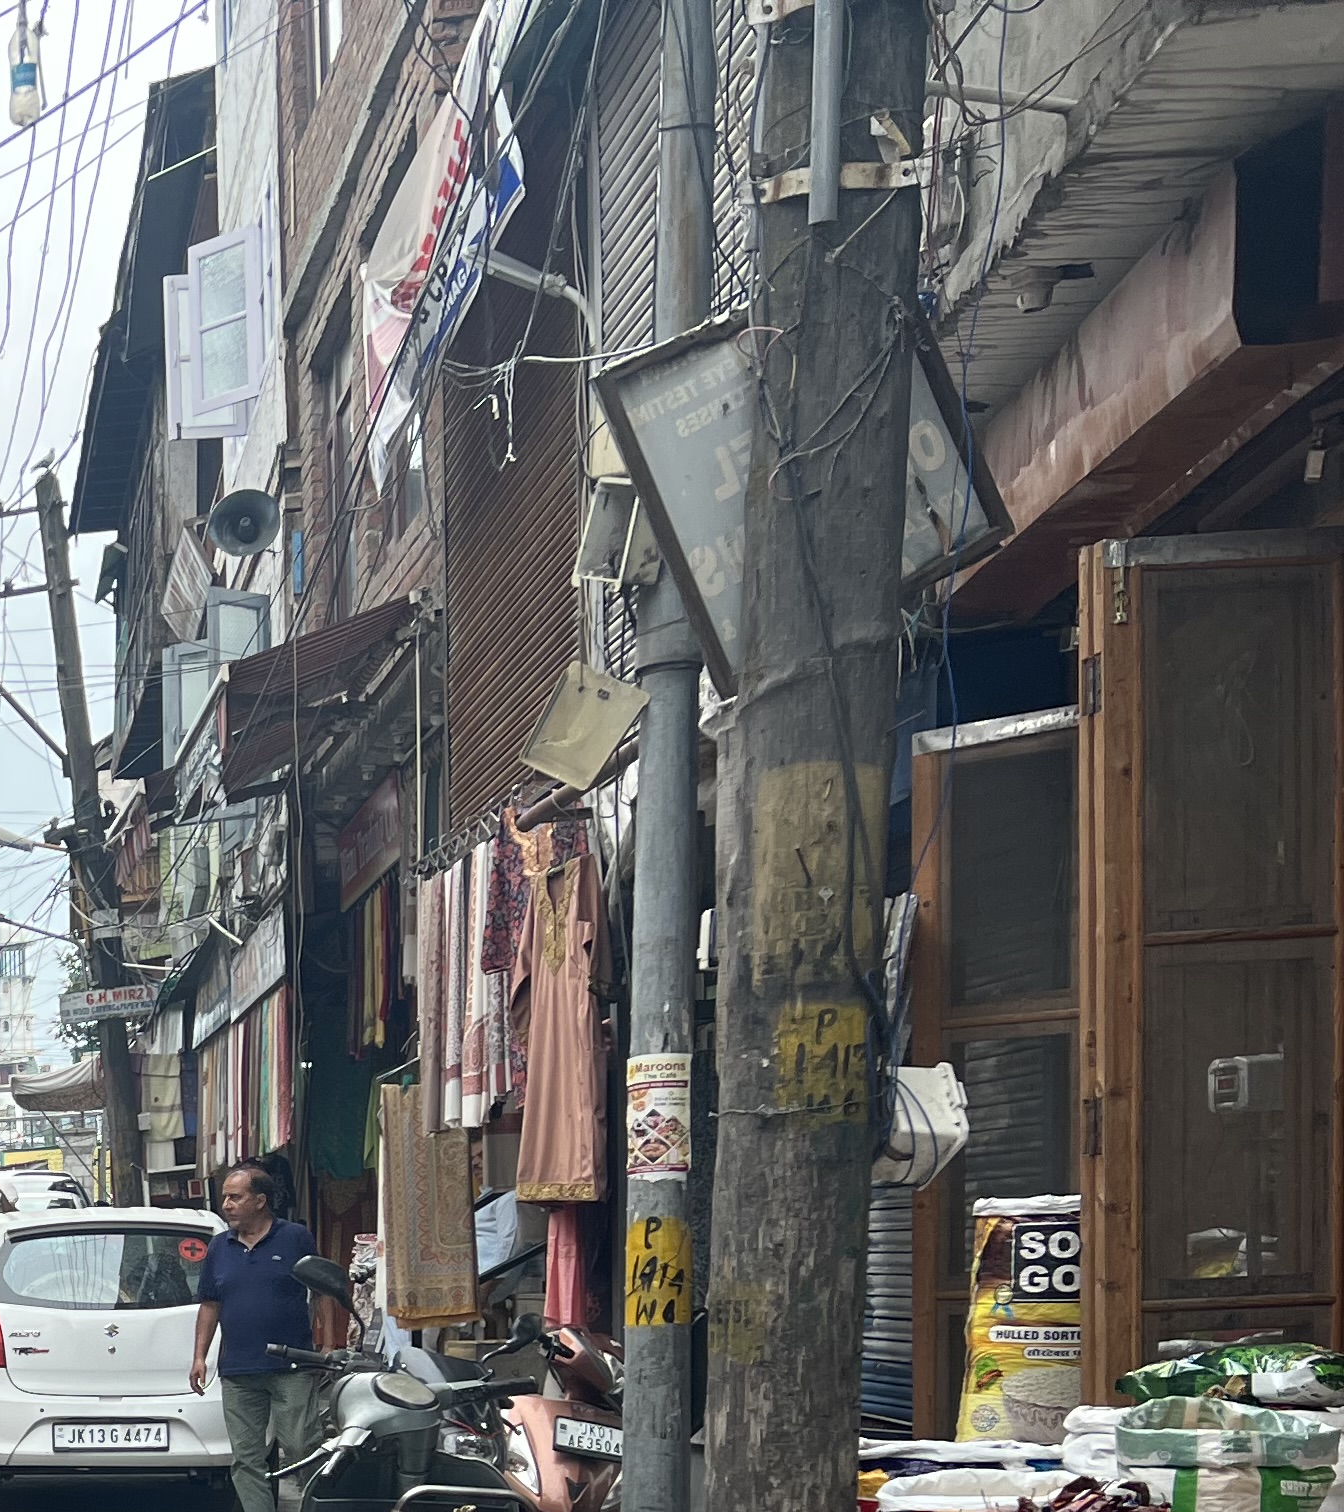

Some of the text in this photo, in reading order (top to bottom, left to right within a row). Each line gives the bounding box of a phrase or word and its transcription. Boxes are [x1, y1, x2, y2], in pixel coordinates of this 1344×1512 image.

[635, 1062, 687, 1074] Maroons
[644, 1216, 663, 1250] P
[1019, 1230, 1081, 1260] SO
[1018, 1264, 1081, 1294] GO
[995, 1329, 1040, 1341] HULLED
[581, 1423, 613, 1441] JK01
